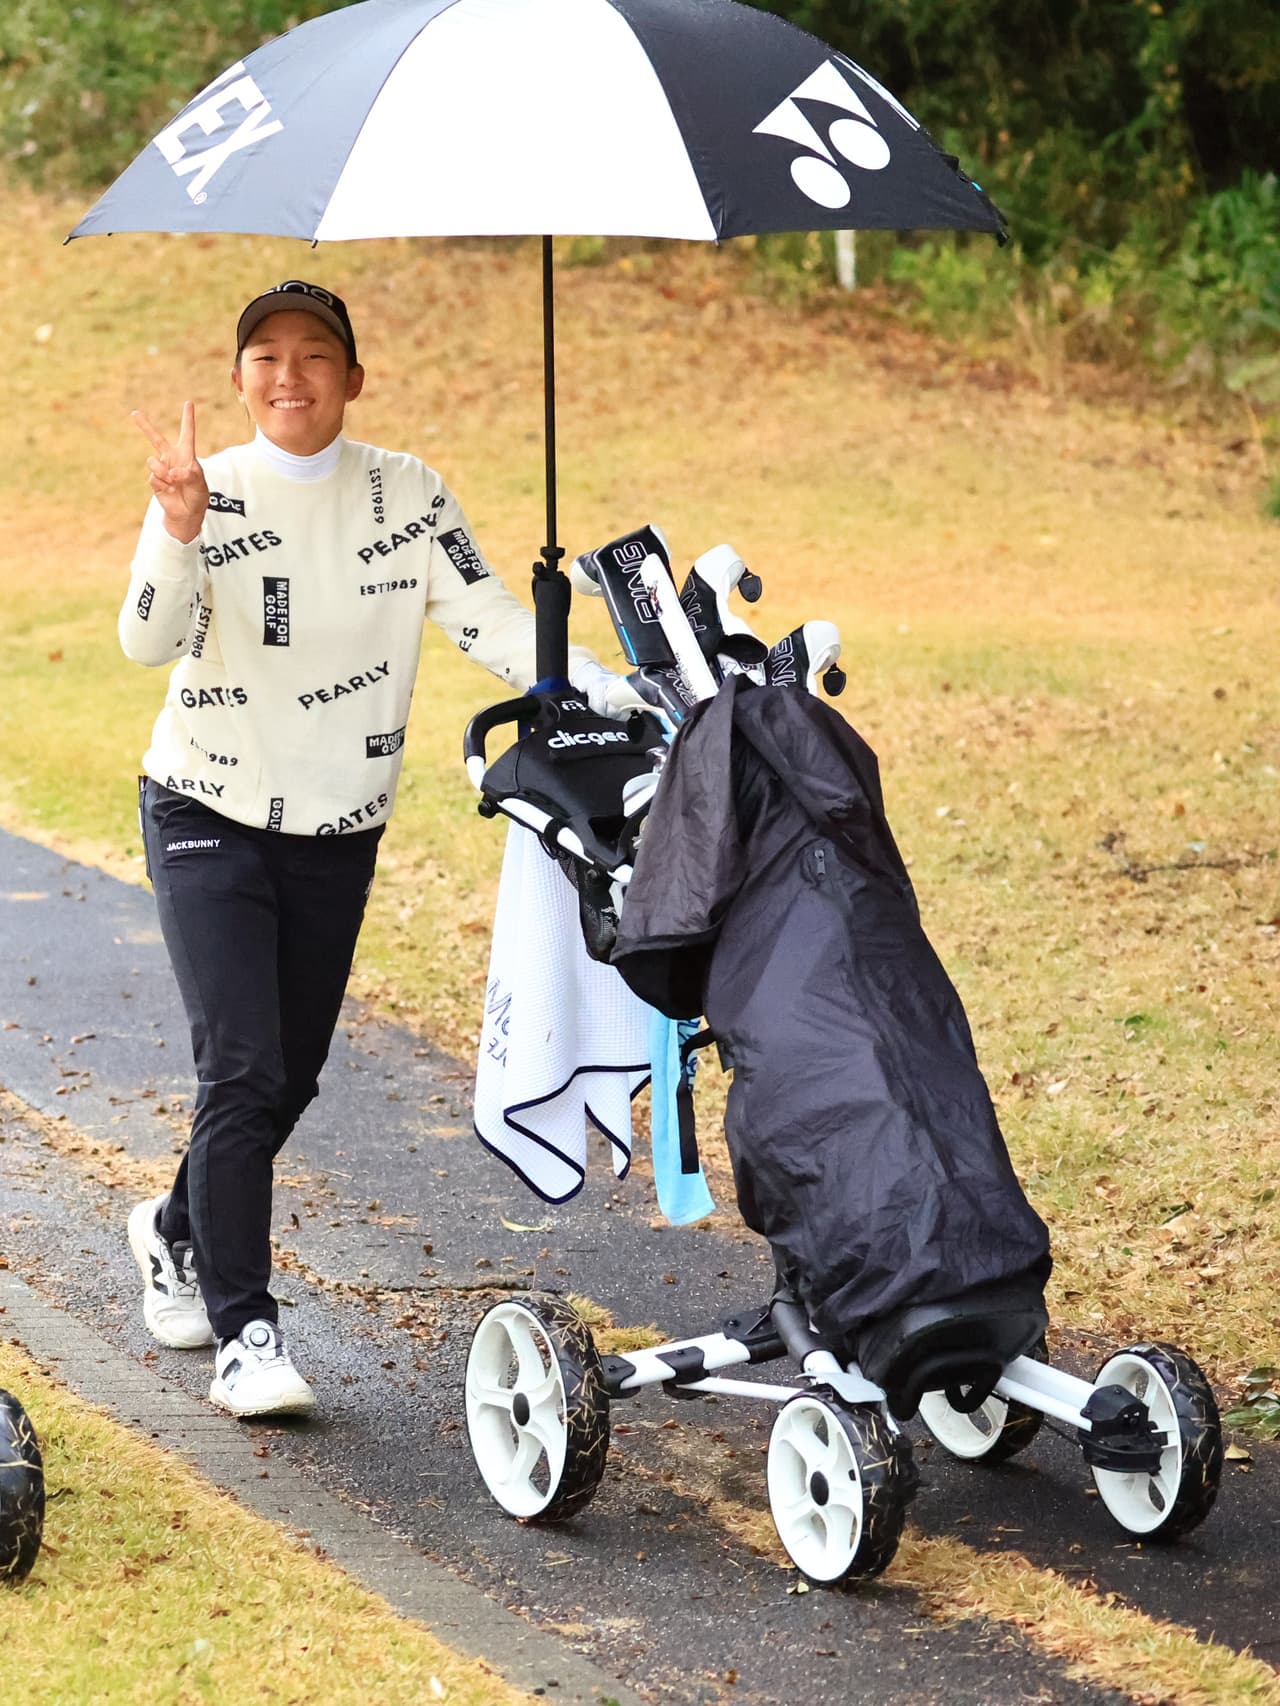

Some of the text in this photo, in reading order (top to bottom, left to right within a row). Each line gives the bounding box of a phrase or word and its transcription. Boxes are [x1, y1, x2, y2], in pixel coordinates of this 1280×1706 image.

[369, 467, 385, 525] EST1989
[207, 530, 282, 567] GATES
[137, 582, 155, 618] GOLF
[360, 578, 417, 596] EST1989
[265, 594, 277, 629] GOLF
[276, 581, 288, 643] MADE FOR
[298, 660, 391, 710] PEARLY
[547, 730, 630, 749] clicgea
[316, 793, 389, 837] GATES
[167, 839, 221, 852] JACKBUNNY
